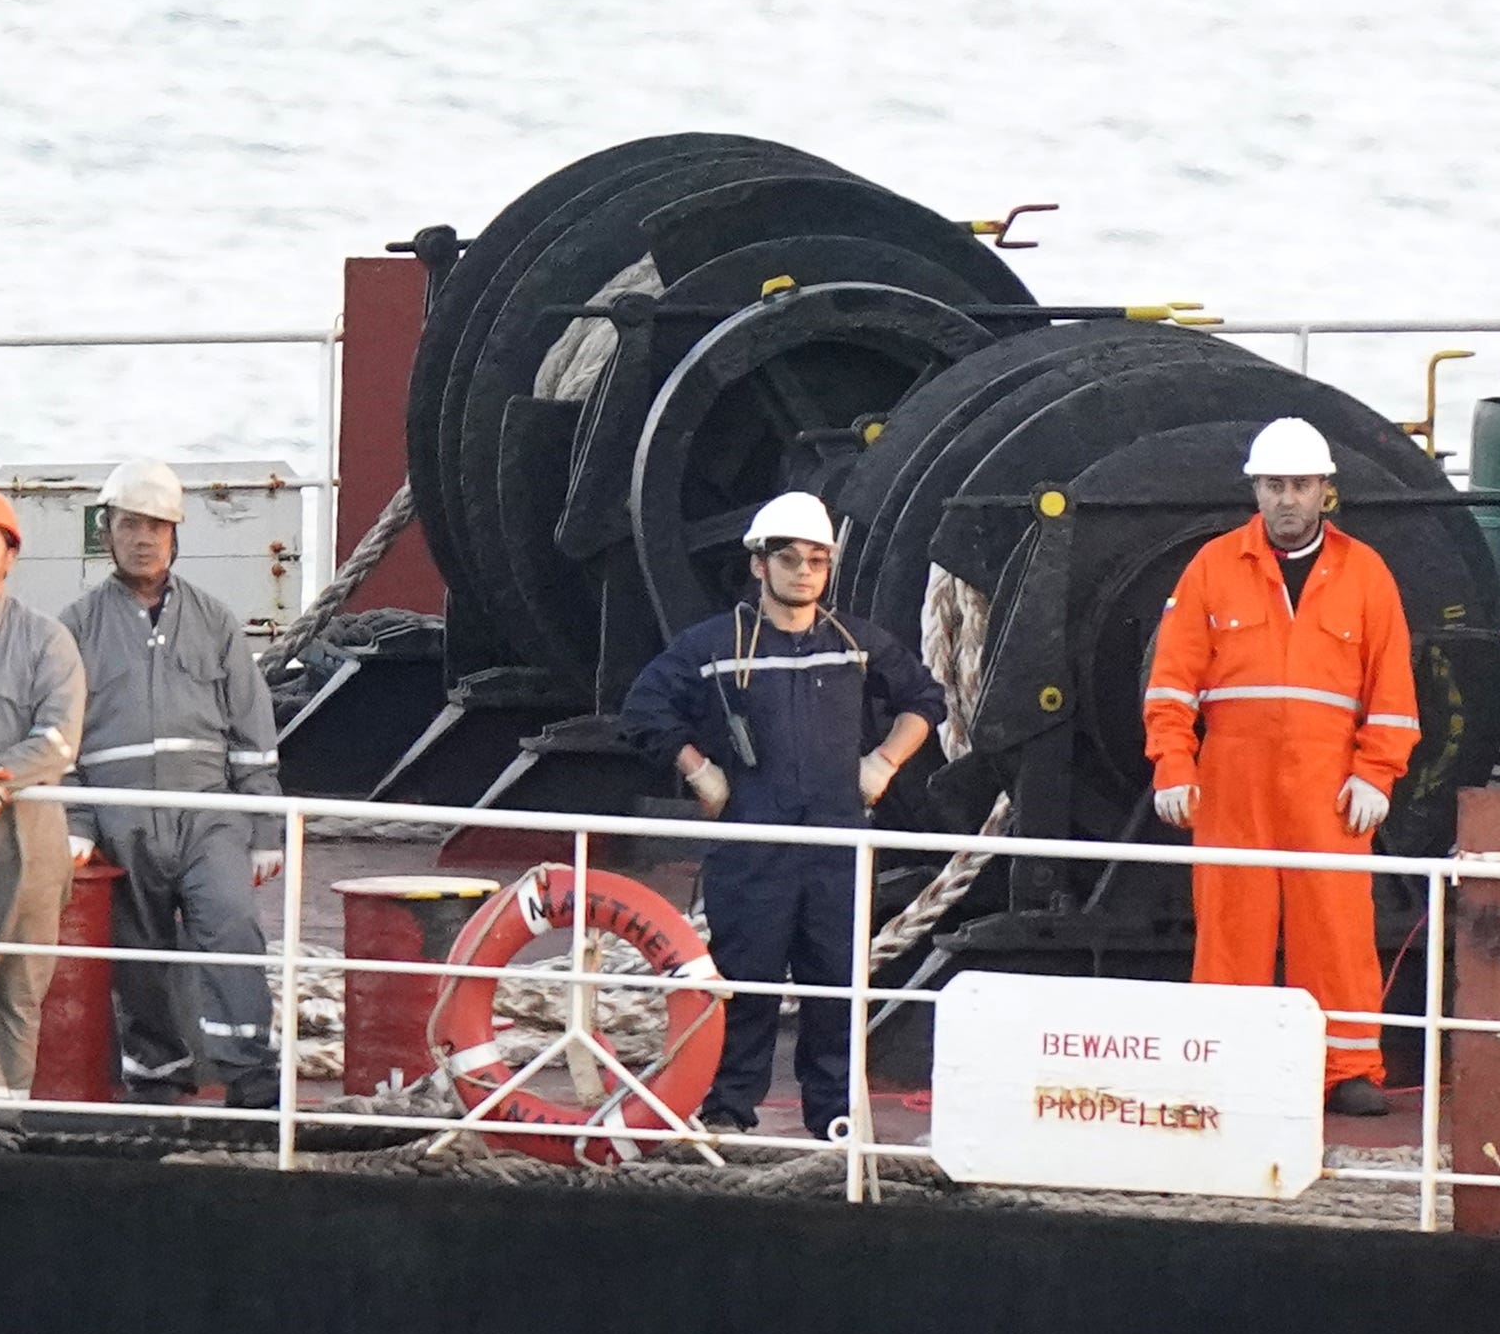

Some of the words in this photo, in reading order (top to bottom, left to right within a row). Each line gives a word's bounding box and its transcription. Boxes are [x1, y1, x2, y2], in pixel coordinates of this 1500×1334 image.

[1043, 1033, 1161, 1060] BEWARE
[1183, 1039, 1221, 1062] OF
[1037, 1095, 1221, 1130] PROPELLER
